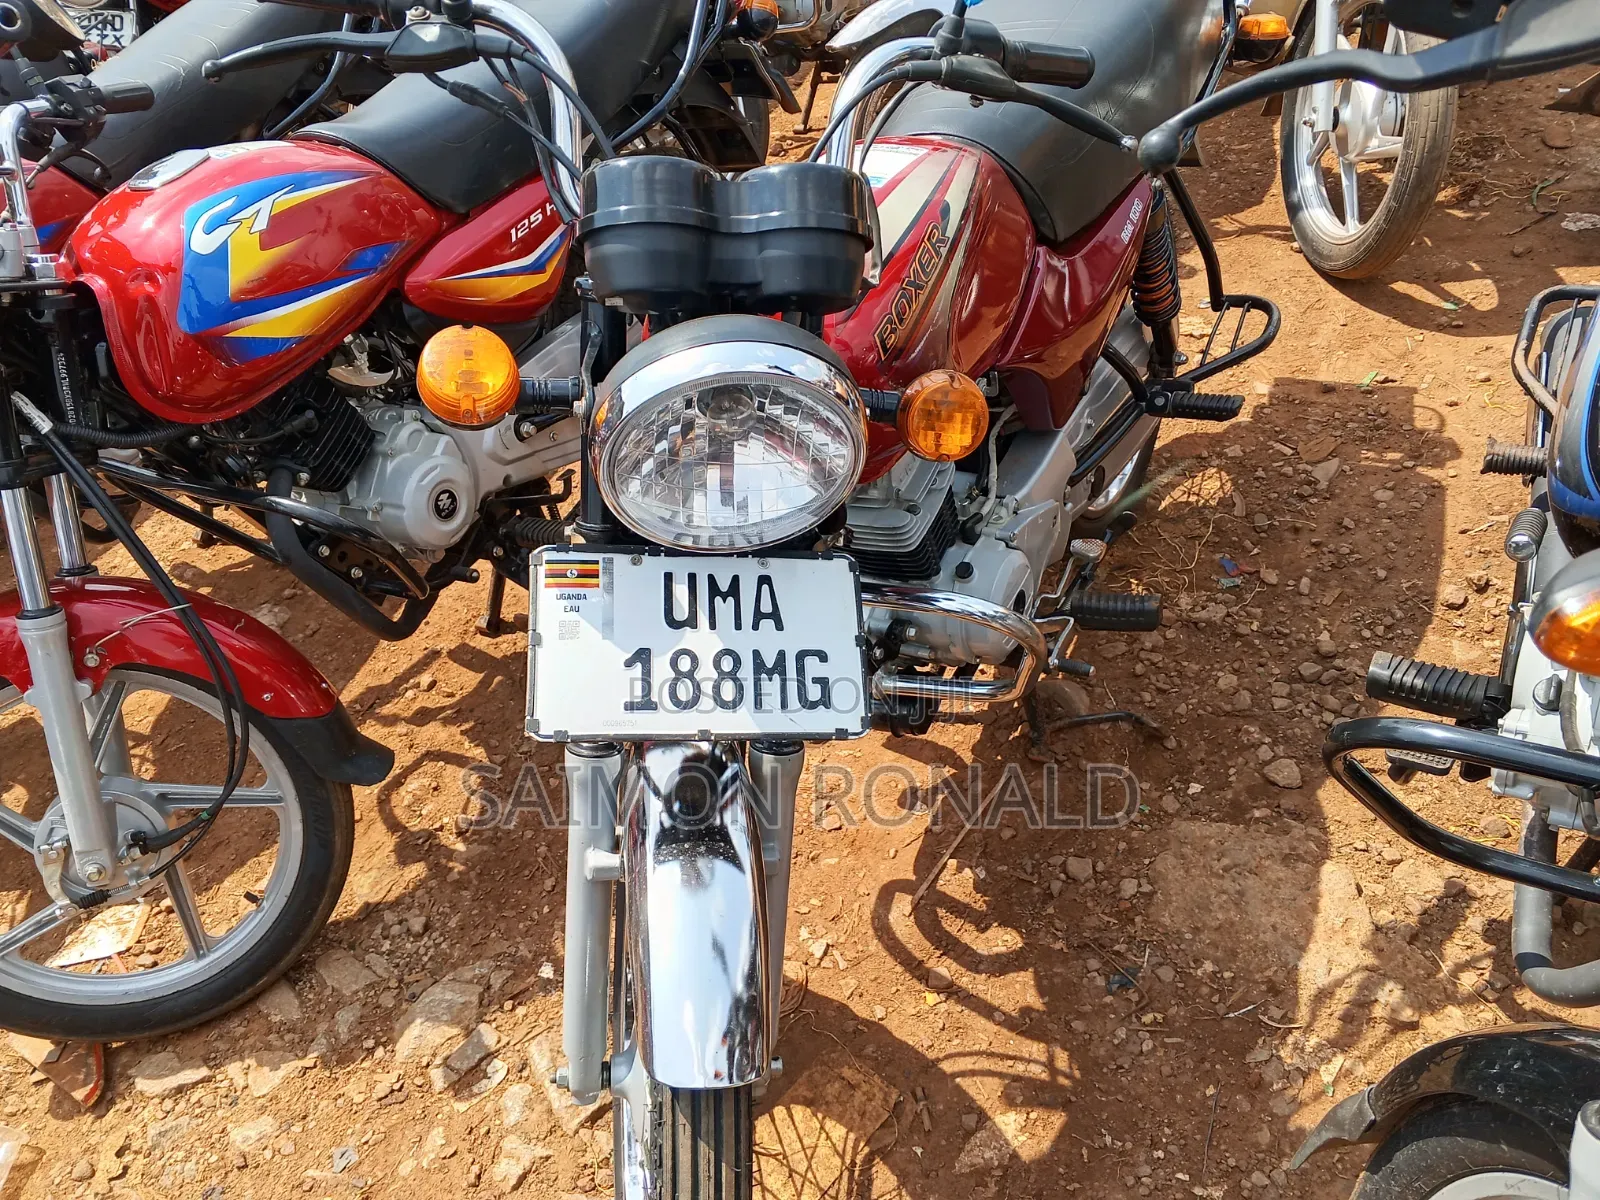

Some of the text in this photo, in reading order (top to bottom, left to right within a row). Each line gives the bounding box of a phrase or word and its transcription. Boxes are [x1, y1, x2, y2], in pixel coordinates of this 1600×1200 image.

[510, 208, 543, 243] 125
[874, 221, 950, 361] BOXER
[555, 593, 587, 601] UGANDA
[563, 605, 580, 613] EAU
[664, 571, 784, 632] UMA
[623, 648, 832, 711] 188MG
